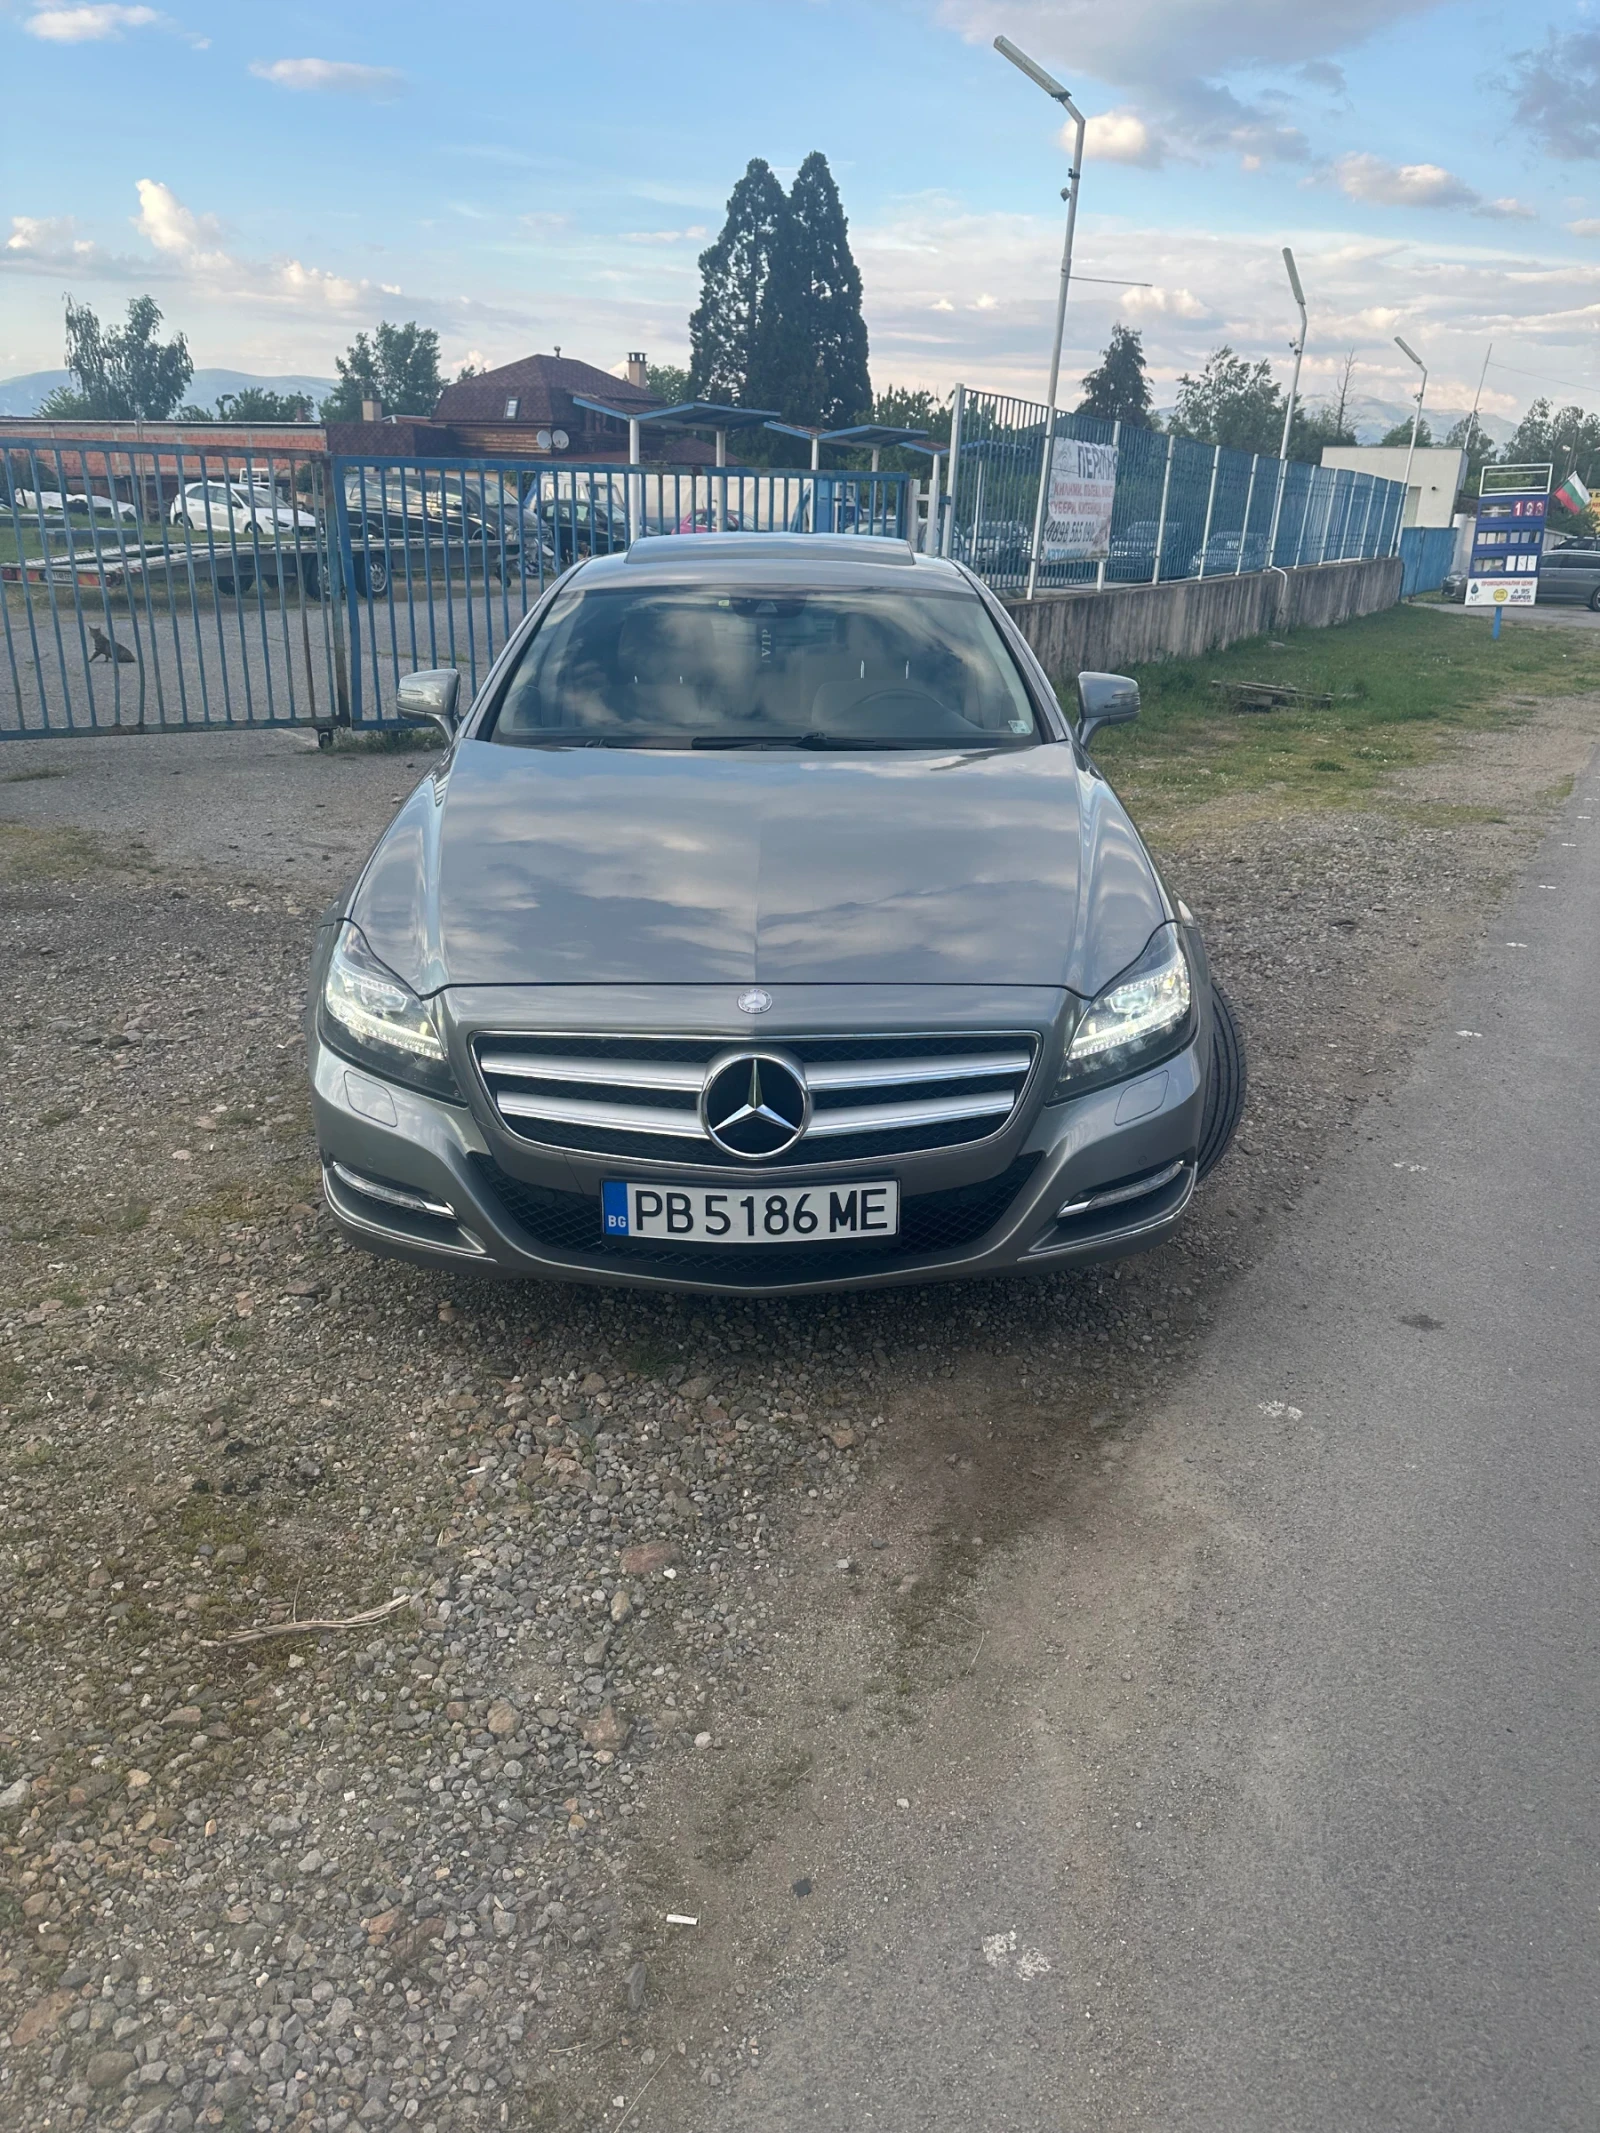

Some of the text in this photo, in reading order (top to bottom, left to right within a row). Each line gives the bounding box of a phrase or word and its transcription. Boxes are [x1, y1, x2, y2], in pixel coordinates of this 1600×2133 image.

[608, 1215, 626, 1228] BG
[635, 1188, 887, 1236] PB 5186 ME
